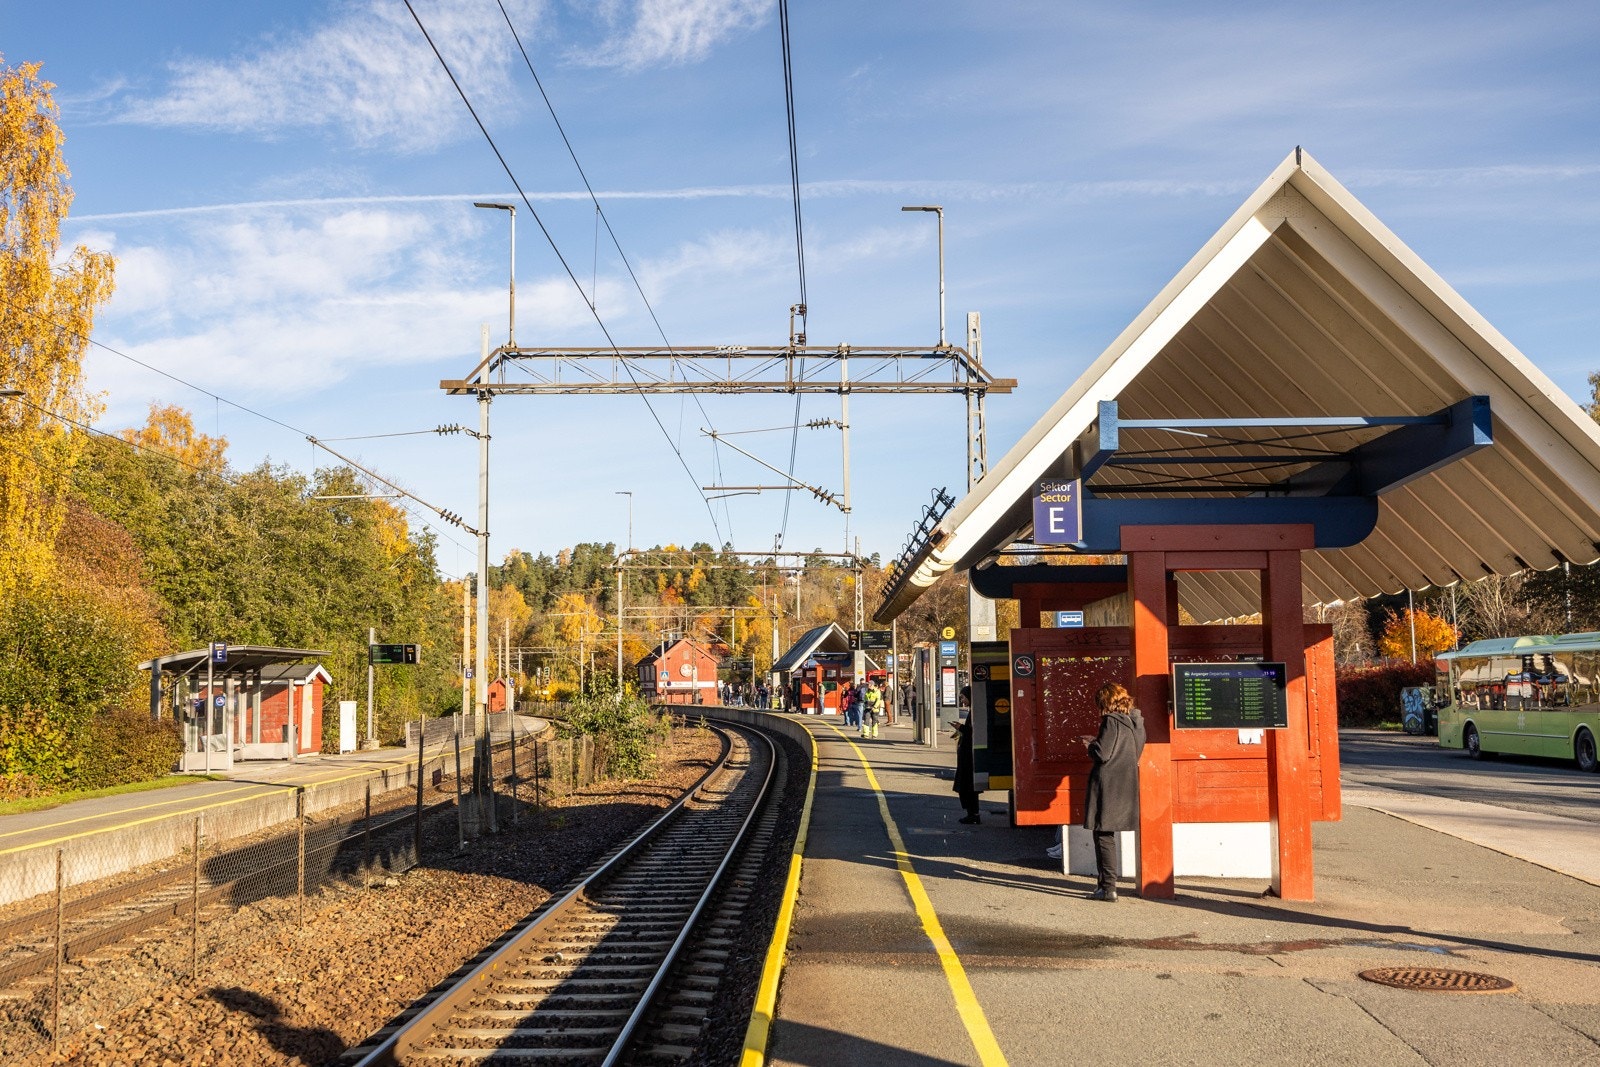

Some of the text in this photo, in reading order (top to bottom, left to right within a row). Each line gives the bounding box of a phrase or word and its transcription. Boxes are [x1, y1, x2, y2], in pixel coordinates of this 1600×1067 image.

[1040, 482, 1072, 492] Sektor
[1040, 493, 1071, 503] Sector
[1049, 507, 1065, 533] E
[217, 650, 222, 659] E
[408, 653, 412, 661] 1
